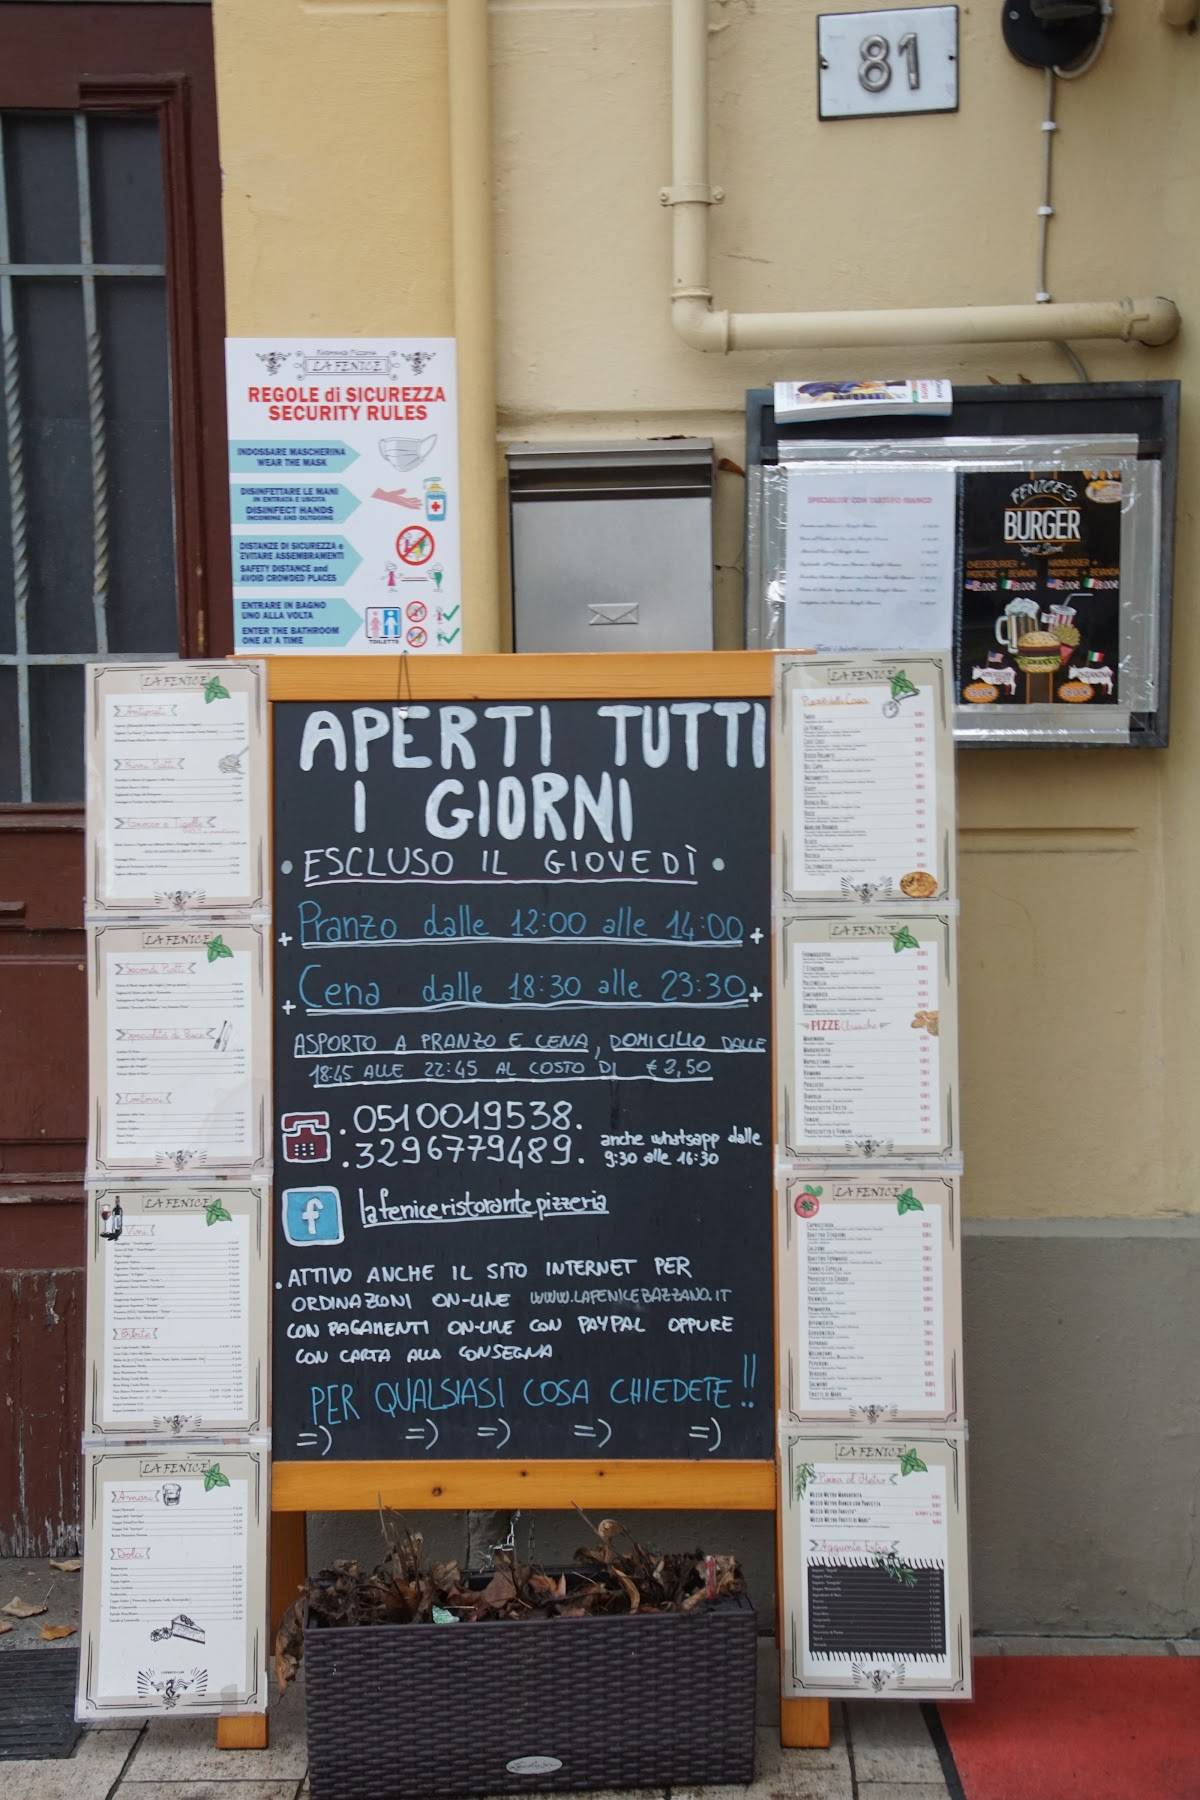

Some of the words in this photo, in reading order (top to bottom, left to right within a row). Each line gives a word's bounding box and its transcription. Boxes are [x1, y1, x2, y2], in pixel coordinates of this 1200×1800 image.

[858, 32, 920, 93] 81
[247, 386, 319, 403] REGOLE
[325, 386, 341, 403] di
[346, 386, 447, 403] SICUREZZA
[269, 405, 361, 421] SECURITY
[367, 405, 428, 421] RULES
[237, 447, 287, 456] INDOSSARE
[289, 447, 346, 456] MASCHERINA
[257, 458, 283, 467] WEAR
[285, 458, 300, 467] THE
[302, 458, 327, 467] MASK
[240, 487, 301, 495] DISINFETTARE
[303, 487, 313, 495] LE
[316, 487, 339, 495] MANI
[245, 506, 297, 514] DISINFECT
[299, 506, 335, 514] HANDS
[1004, 509, 1081, 540] BURGER
[240, 542, 279, 550] DISTANZE
[281, 542, 289, 550] DI
[291, 542, 336, 550] SICUREZZA
[240, 552, 273, 560] EVITARE
[275, 552, 345, 560] ASSEMBRAMENTI
[240, 564, 270, 572] SAFETY
[272, 564, 312, 572] DISTANCE
[313, 564, 329, 572] and
[240, 574, 264, 582] AVOID
[266, 574, 306, 582] CROWDED
[307, 574, 337, 582] PLACES
[241, 601, 282, 609] ENTRARE
[284, 601, 294, 609] IN
[295, 601, 327, 609] BAGNO
[241, 611, 261, 620] UNO
[263, 611, 285, 620] ALLA
[286, 611, 314, 620] VOLTA
[241, 626, 271, 635] ENTER
[272, 626, 289, 635] THE
[290, 626, 340, 635] BATHROOM
[241, 636, 261, 645] ONE
[263, 636, 273, 645] AT
[274, 636, 281, 645] A
[282, 636, 304, 645] TIME
[300, 705, 553, 772] APERTI
[598, 702, 767, 771] TUTTI
[353, 780, 367, 834] I
[425, 771, 633, 843] GIORNI
[304, 847, 454, 881] ESCLUSO
[482, 850, 508, 876] IL
[543, 844, 697, 876] GIOVEDÌ
[298, 901, 397, 942] Pranzo
[423, 905, 490, 937] dalle
[510, 908, 587, 937] 12:00
[602, 905, 648, 938] alle
[665, 908, 744, 942] 14:00
[145, 934, 164, 946] LA
[166, 934, 210, 946] FENICE
[299, 964, 381, 1009] Cena
[422, 971, 483, 1003] dalle
[508, 972, 582, 1000] 18:30
[598, 968, 642, 999] alle
[660, 969, 747, 999] 23:30
[294, 1033, 377, 1056] ASPORTO
[394, 1034, 407, 1051] A
[421, 1032, 496, 1050] PRANZO
[508, 1032, 524, 1049] E
[424, 1060, 478, 1078] 22:45
[495, 1061, 517, 1077] AL
[529, 1061, 585, 1075] COSTO
[598, 1060, 617, 1077] DI
[600, 1130, 645, 1147] anche
[650, 1128, 721, 1151] whatsapp
[727, 1125, 763, 1146] dalle
[603, 1151, 638, 1168] 9:30
[643, 1148, 672, 1166] alle
[676, 1151, 720, 1167] 16:30
[834, 1186, 853, 1198] LA
[856, 1186, 900, 1198] FENICE
[145, 1197, 164, 1209] LA
[166, 1197, 209, 1209] FENICE
[287, 1266, 353, 1287] ATTIVO
[366, 1264, 435, 1284] ANCHE
[452, 1265, 474, 1281] IL
[486, 1261, 528, 1280] SITO
[545, 1258, 638, 1277] INTERNET
[654, 1256, 693, 1278] PER
[286, 1322, 320, 1339] CON
[327, 1319, 430, 1337] PAGAMENTI
[529, 1317, 563, 1333] CON
[577, 1315, 646, 1334] PAYPAL
[667, 1316, 734, 1333] OPPURE
[295, 1348, 329, 1365] CON
[339, 1348, 392, 1364] CARTA
[458, 1343, 553, 1361] CONSEGNA
[310, 1384, 361, 1426] PER
[374, 1376, 505, 1419] QUALSIASI
[523, 1378, 590, 1407] COSA
[838, 1445, 857, 1457] LA
[859, 1445, 904, 1457] FENICE
[142, 1461, 162, 1474] LA
[164, 1461, 209, 1474] FENICE
